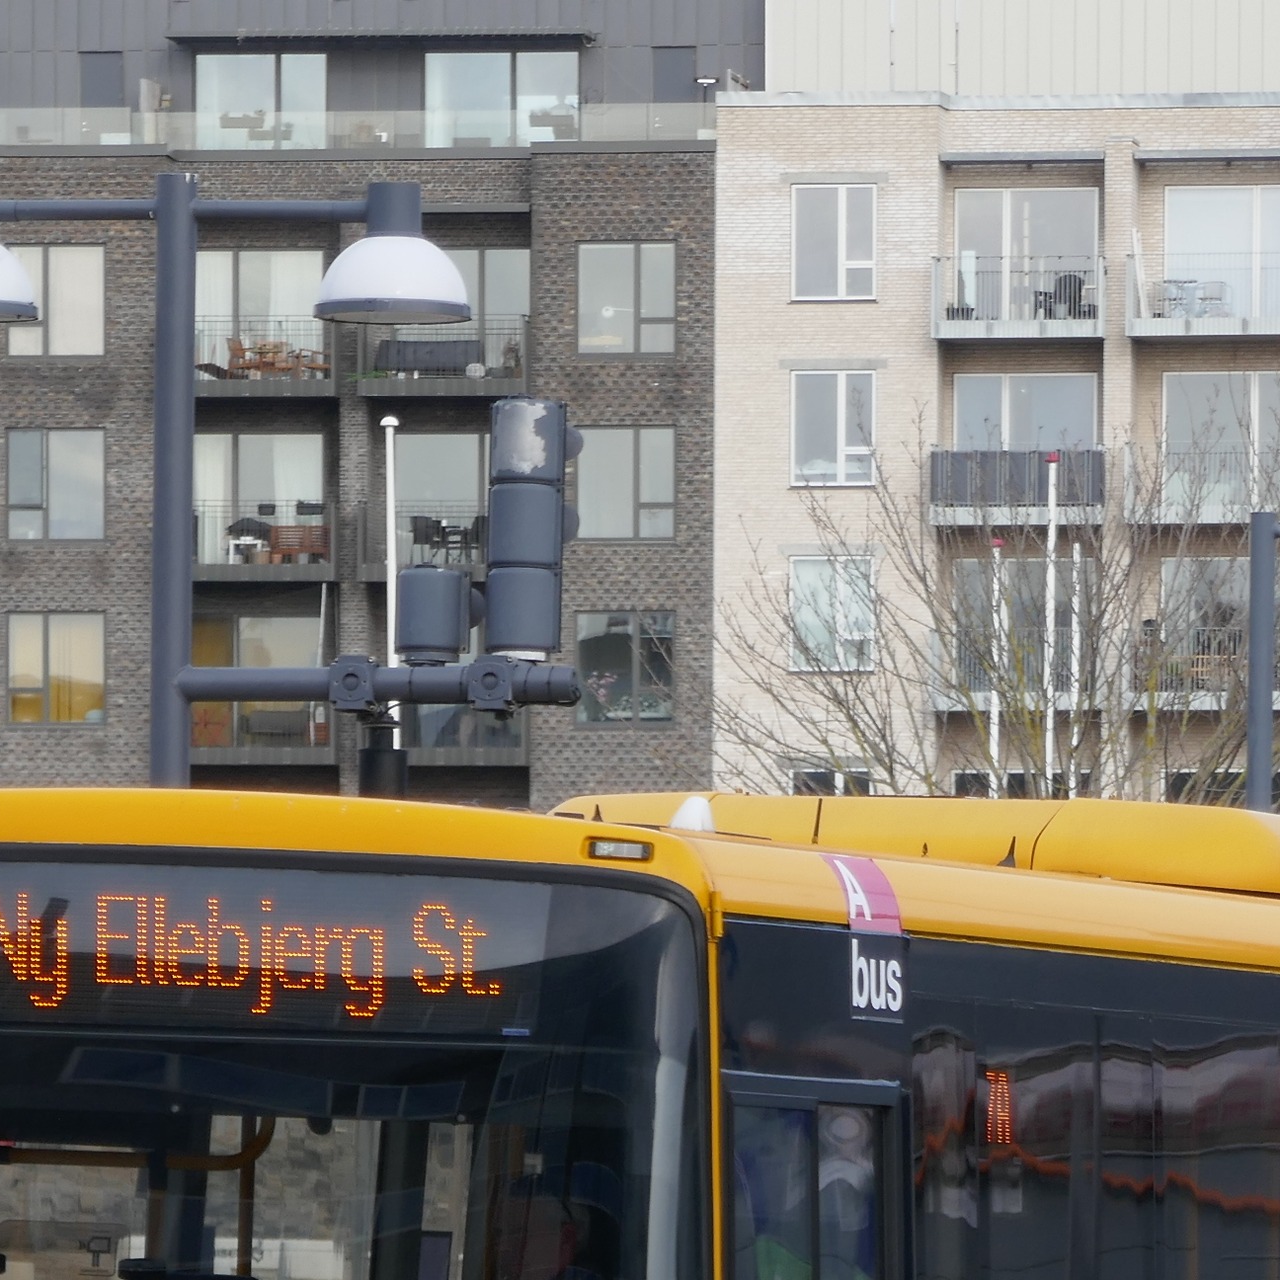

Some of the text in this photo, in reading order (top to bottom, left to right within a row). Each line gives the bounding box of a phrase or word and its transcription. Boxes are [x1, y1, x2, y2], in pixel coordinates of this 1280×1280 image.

[833, 858, 872, 921] A
[96, 895, 384, 1018] Ellebjerg
[413, 904, 501, 995] St.
[851, 938, 903, 1013] bus
